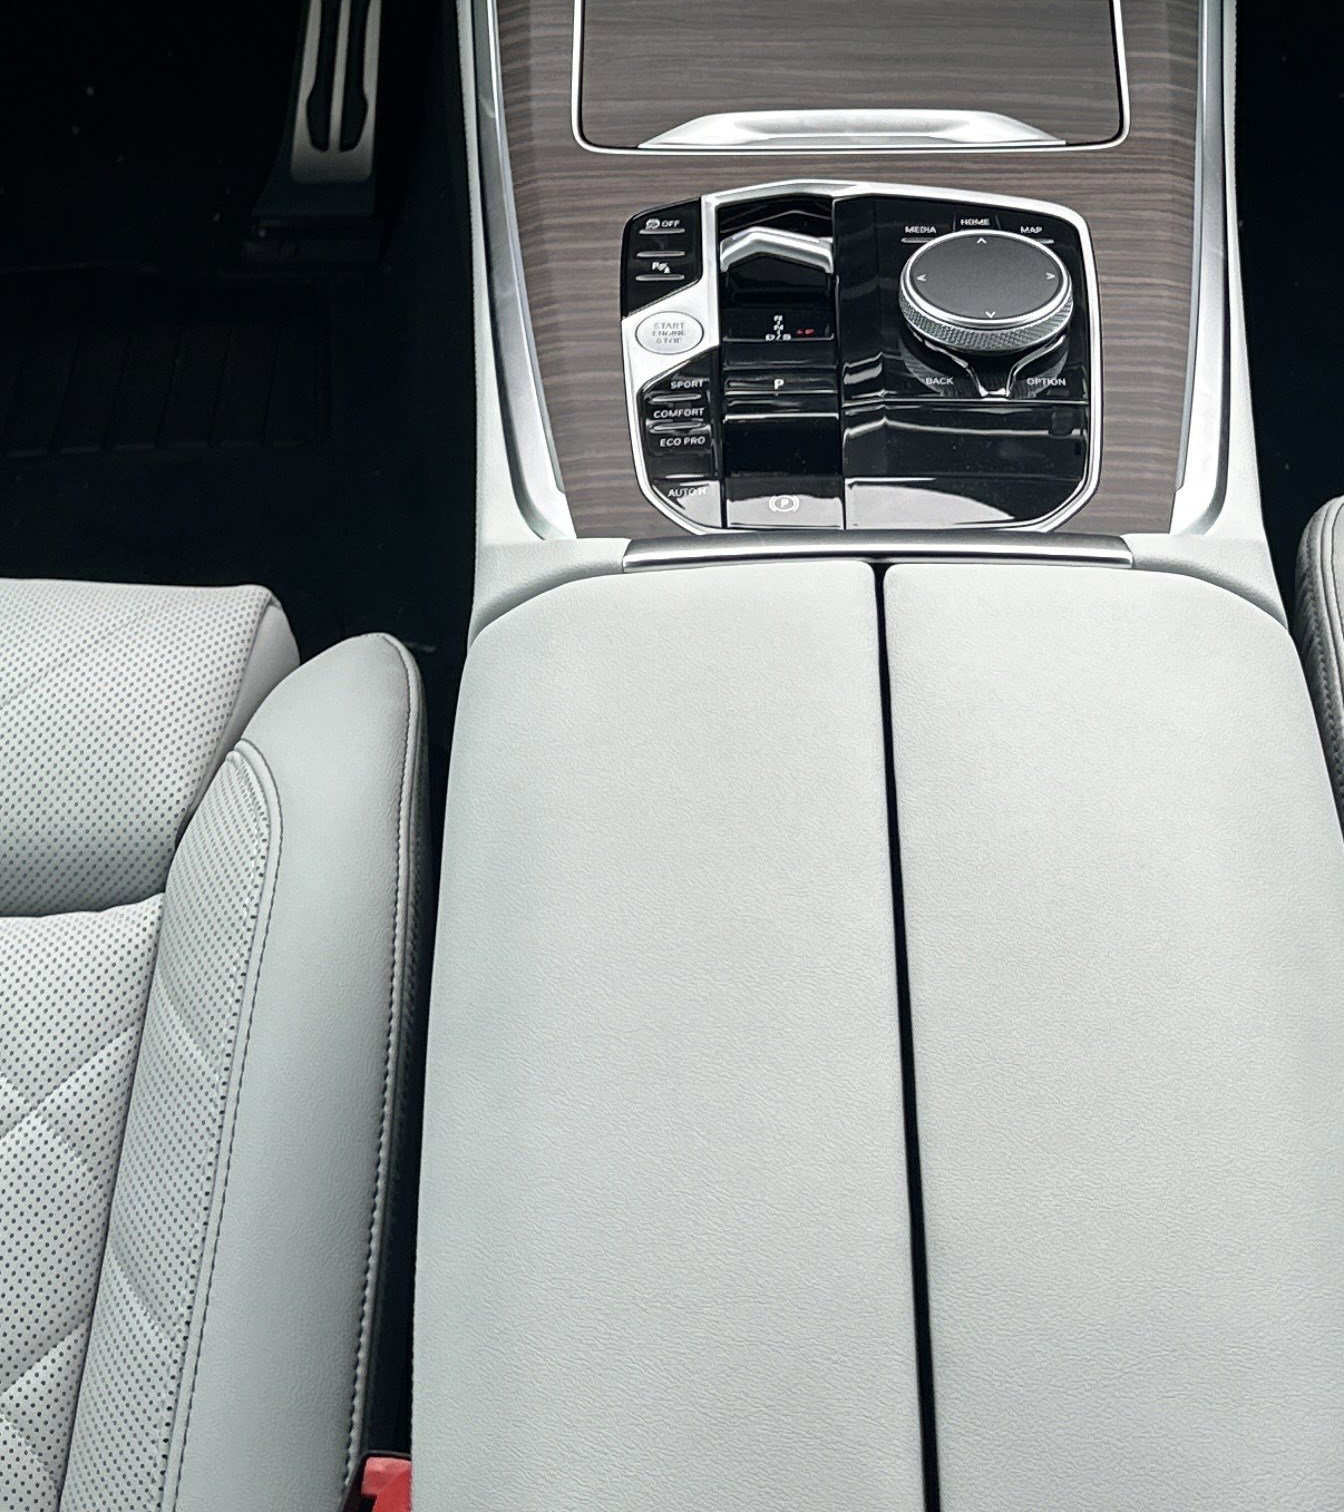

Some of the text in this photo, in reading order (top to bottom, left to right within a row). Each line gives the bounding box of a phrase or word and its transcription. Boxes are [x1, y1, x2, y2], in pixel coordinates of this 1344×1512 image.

[905, 226, 937, 234] MEDIA
[1020, 226, 1042, 234] MAP
[670, 379, 704, 389] SPORT
[774, 378, 785, 390] P
[925, 377, 954, 385] BACK
[1026, 377, 1067, 386] OPTION
[653, 408, 705, 419] COMFORT
[660, 436, 706, 447] ECO PRO
